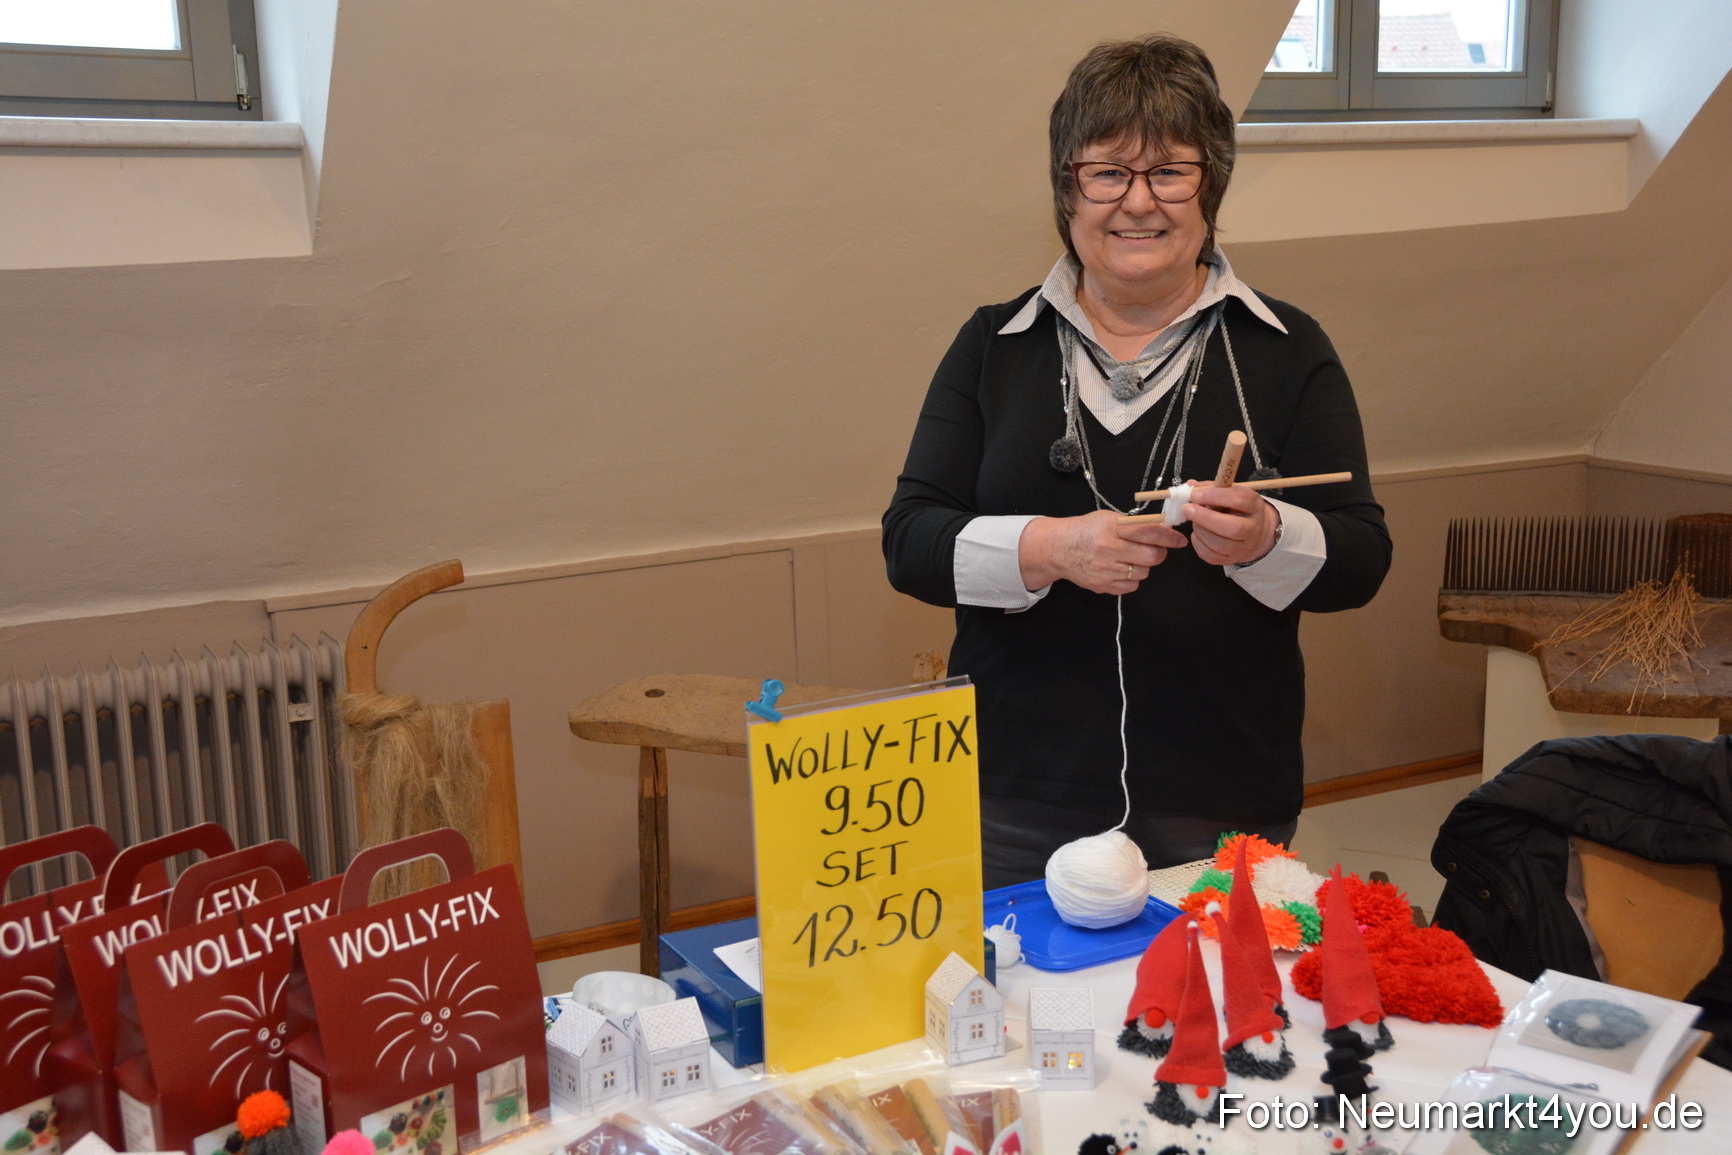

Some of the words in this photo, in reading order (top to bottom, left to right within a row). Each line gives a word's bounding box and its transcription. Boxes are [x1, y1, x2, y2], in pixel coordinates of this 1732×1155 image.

[766, 714, 971, 785] WOLLY-FIX
[820, 777, 925, 835] 9.50
[816, 840, 909, 887] SET
[329, 886, 501, 969] WOLLY-FIX
[792, 888, 942, 968] 12.50
